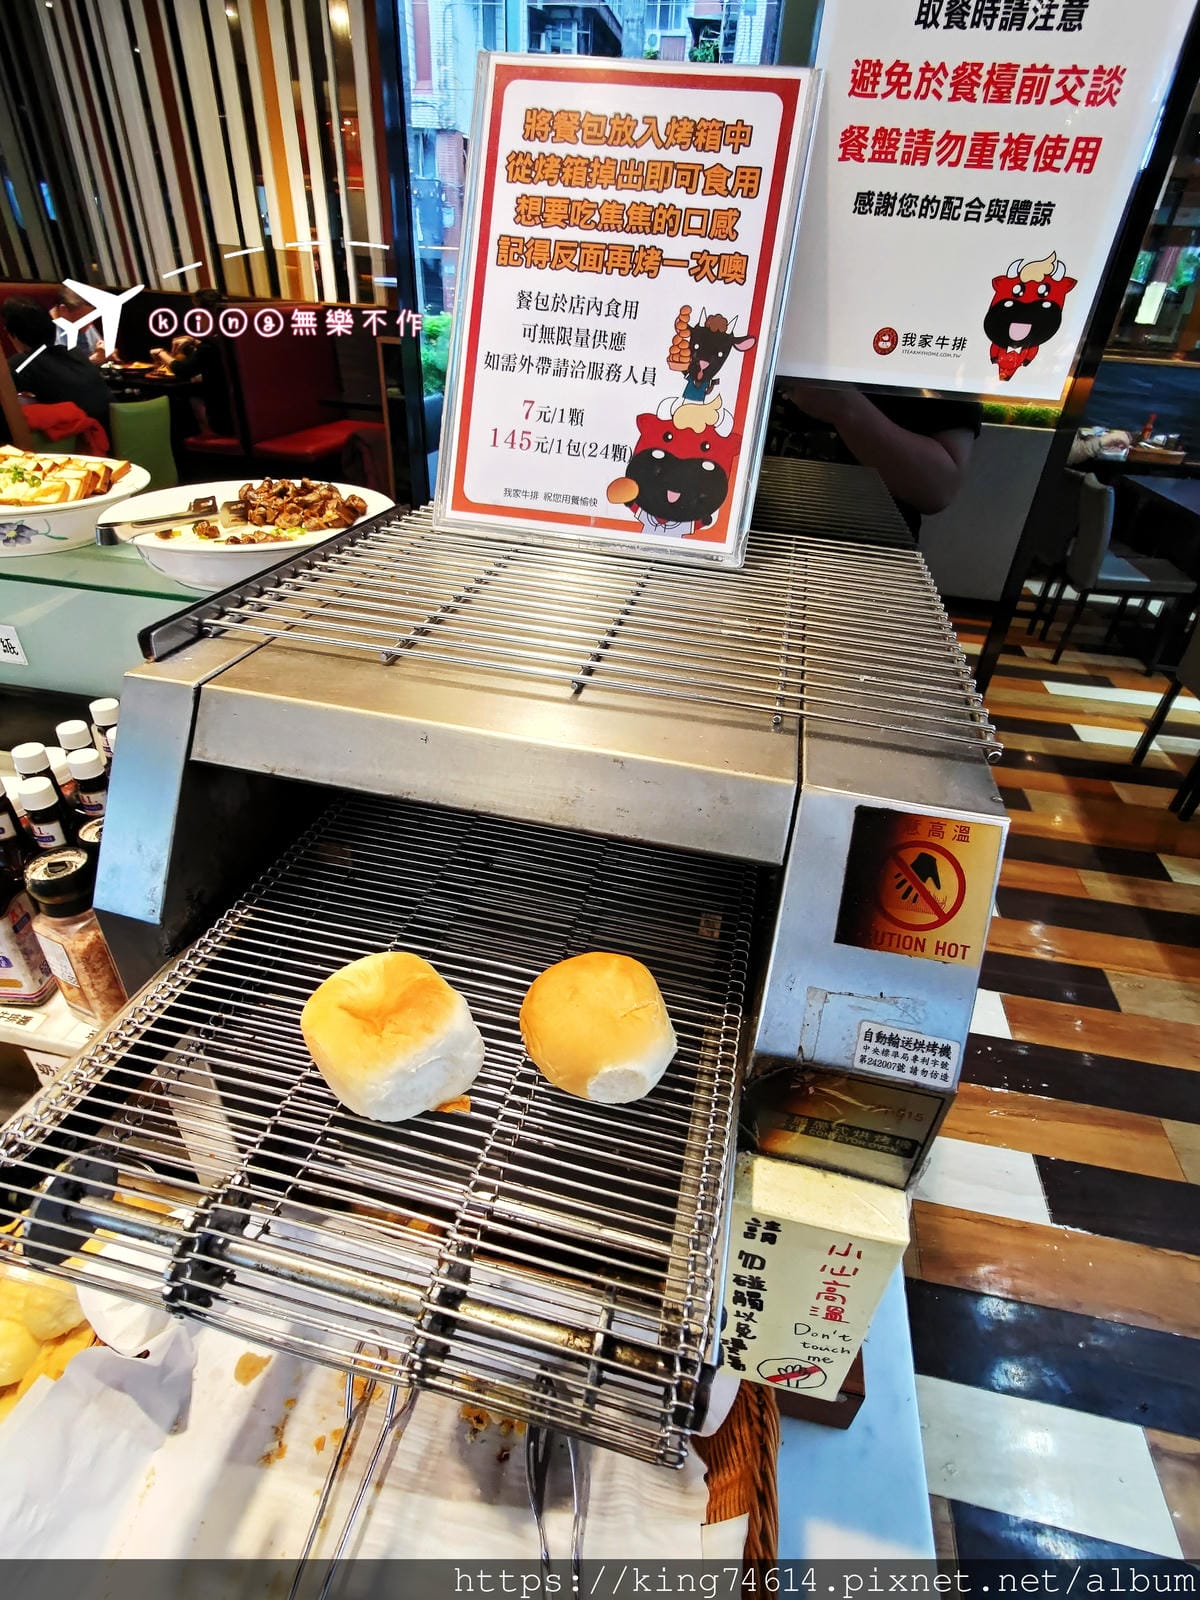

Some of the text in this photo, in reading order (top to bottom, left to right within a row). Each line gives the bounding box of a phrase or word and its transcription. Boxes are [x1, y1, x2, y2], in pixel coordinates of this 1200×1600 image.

[914, 0, 1089, 32] 取餐時請注意
[848, 58, 1127, 108] 避免於餐檯前交談
[522, 108, 753, 154] 將餐包放入烤箱中
[837, 124, 1104, 174] 餐盤請勿重複使用
[505, 151, 762, 198] 從烤箱掉出即可食用
[513, 194, 740, 241] 想要吃焦焦的口感
[852, 190, 1056, 227] 感謝您的配合與體諒
[496, 234, 749, 286] 記得反面再烤一次噢
[516, 290, 640, 320] 餐包於店內食用
[522, 323, 627, 351] 可無限量供應
[901, 332, 968, 351] 我家牛排
[483, 351, 657, 386] 如需外帶請洽服務人員
[522, 399, 585, 427] 7元/1顆
[503, 487, 539, 500] 我家牛排
[934, 940, 971, 961] HOT
[863, 1028, 952, 1060] 自動輸送烘烤機
[859, 1054, 950, 1083] 第242007號 請勿仿造
[794, 1322, 853, 1342] Don't
[800, 1341, 851, 1355] touch
[807, 1355, 834, 1364] me
